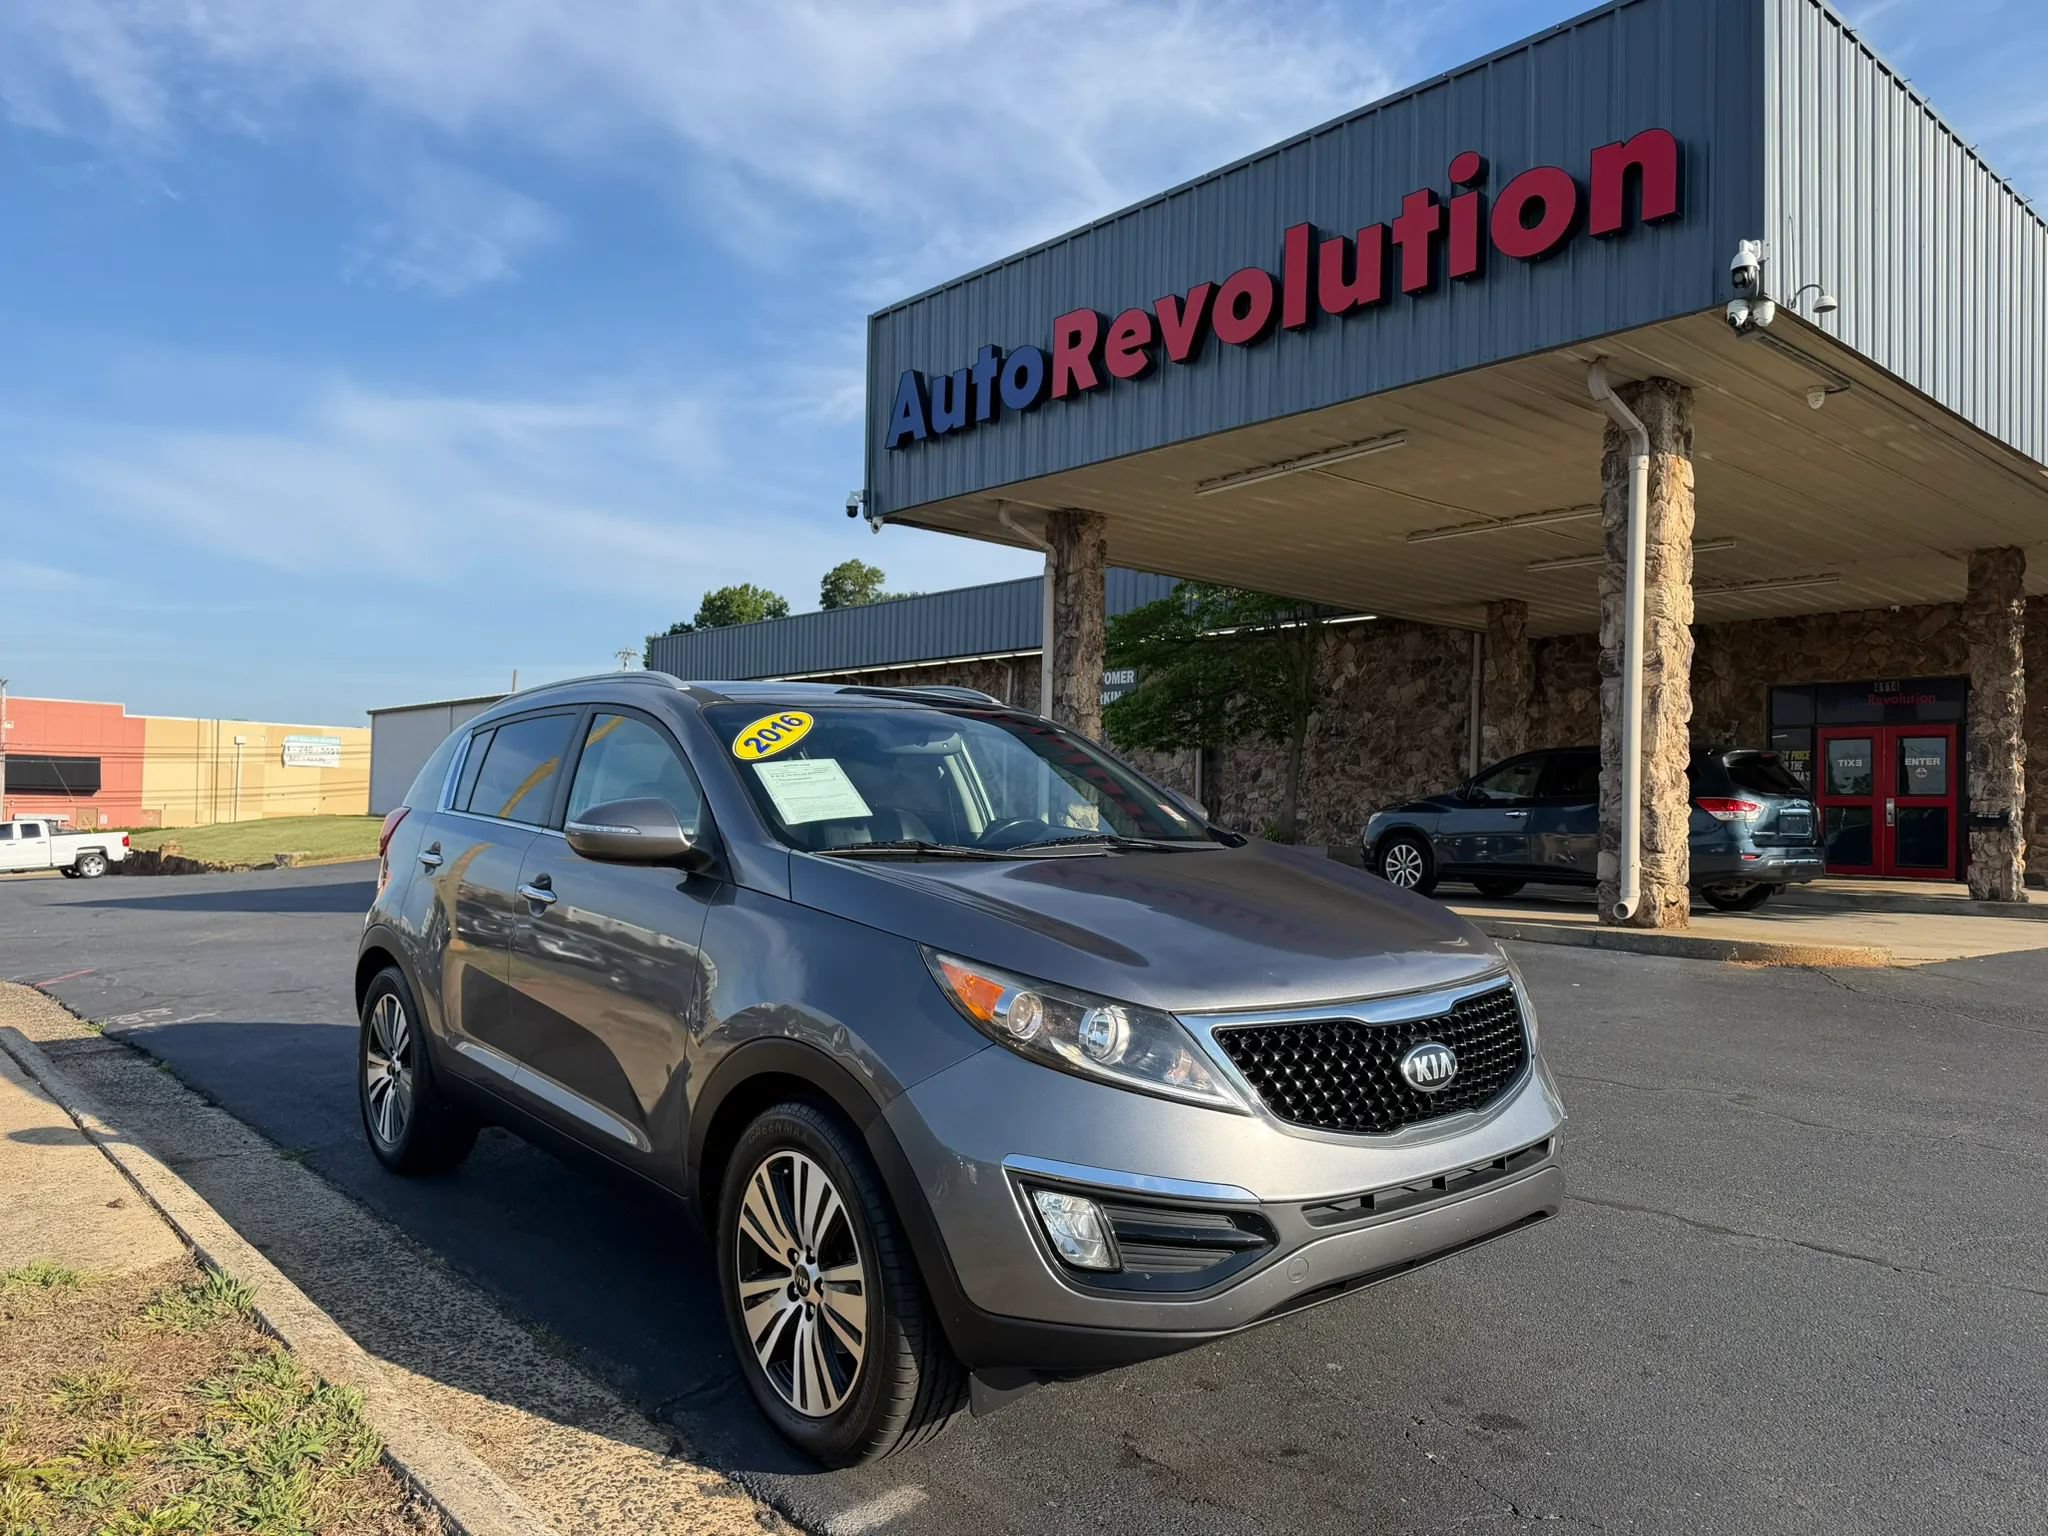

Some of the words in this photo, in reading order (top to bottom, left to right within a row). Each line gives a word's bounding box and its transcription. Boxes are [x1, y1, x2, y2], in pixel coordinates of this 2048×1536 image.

[884, 127, 1680, 450] AutoRevolution
[1102, 670, 1134, 685] OMER
[1867, 692, 1936, 704] Revolution
[743, 715, 803, 754] 2016
[1904, 757, 1941, 766] ENTER
[1412, 1052, 1453, 1082] KIA
